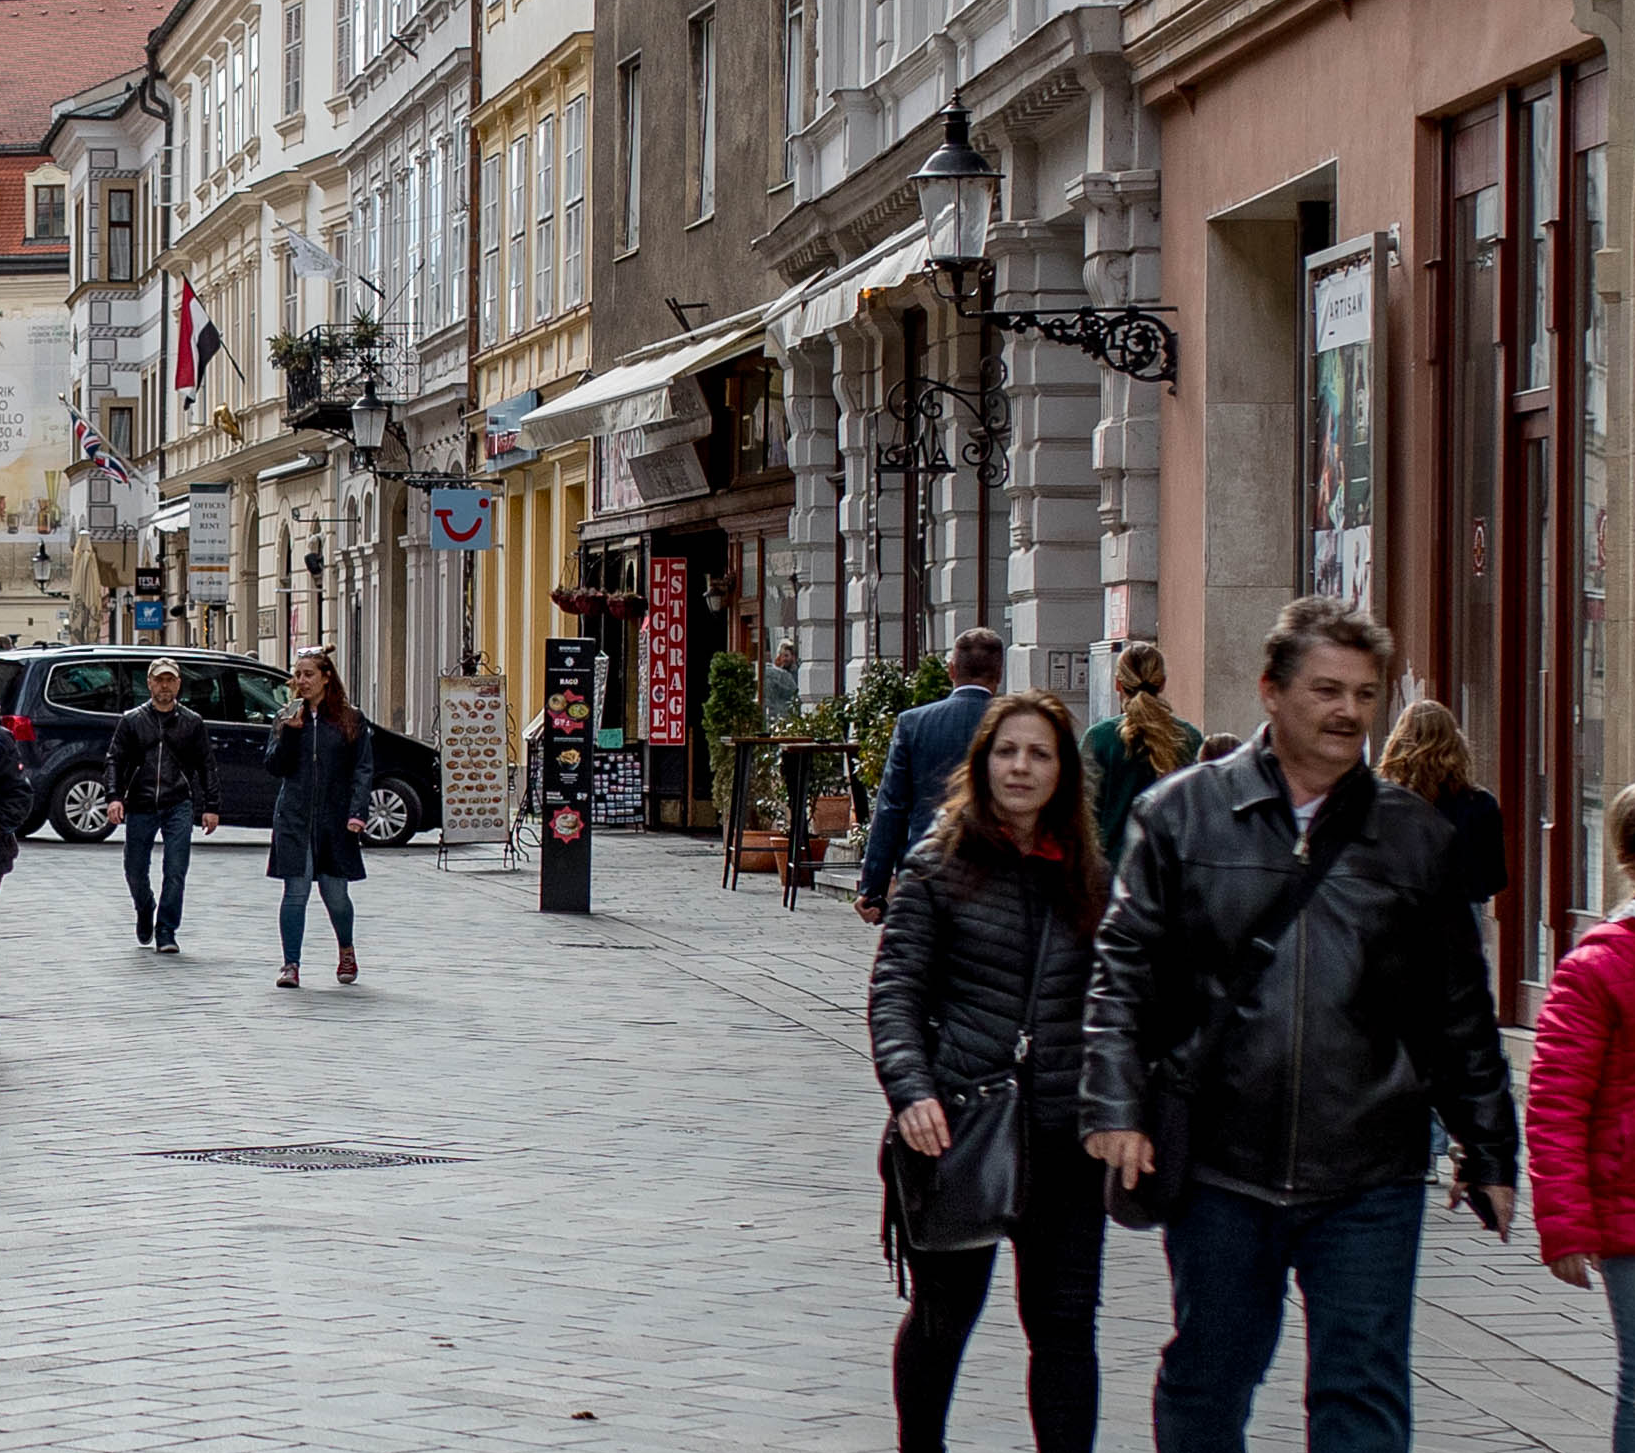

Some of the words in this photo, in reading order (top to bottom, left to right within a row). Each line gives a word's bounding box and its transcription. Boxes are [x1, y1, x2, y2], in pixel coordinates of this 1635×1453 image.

[1330, 292, 1363, 321] ARTISAN
[194, 501, 226, 509] OFFICES
[199, 522, 220, 530] RENT
[137, 576, 161, 587] TESLA
[652, 564, 666, 727] LUGGAGE
[669, 576, 684, 739] STORAGE
